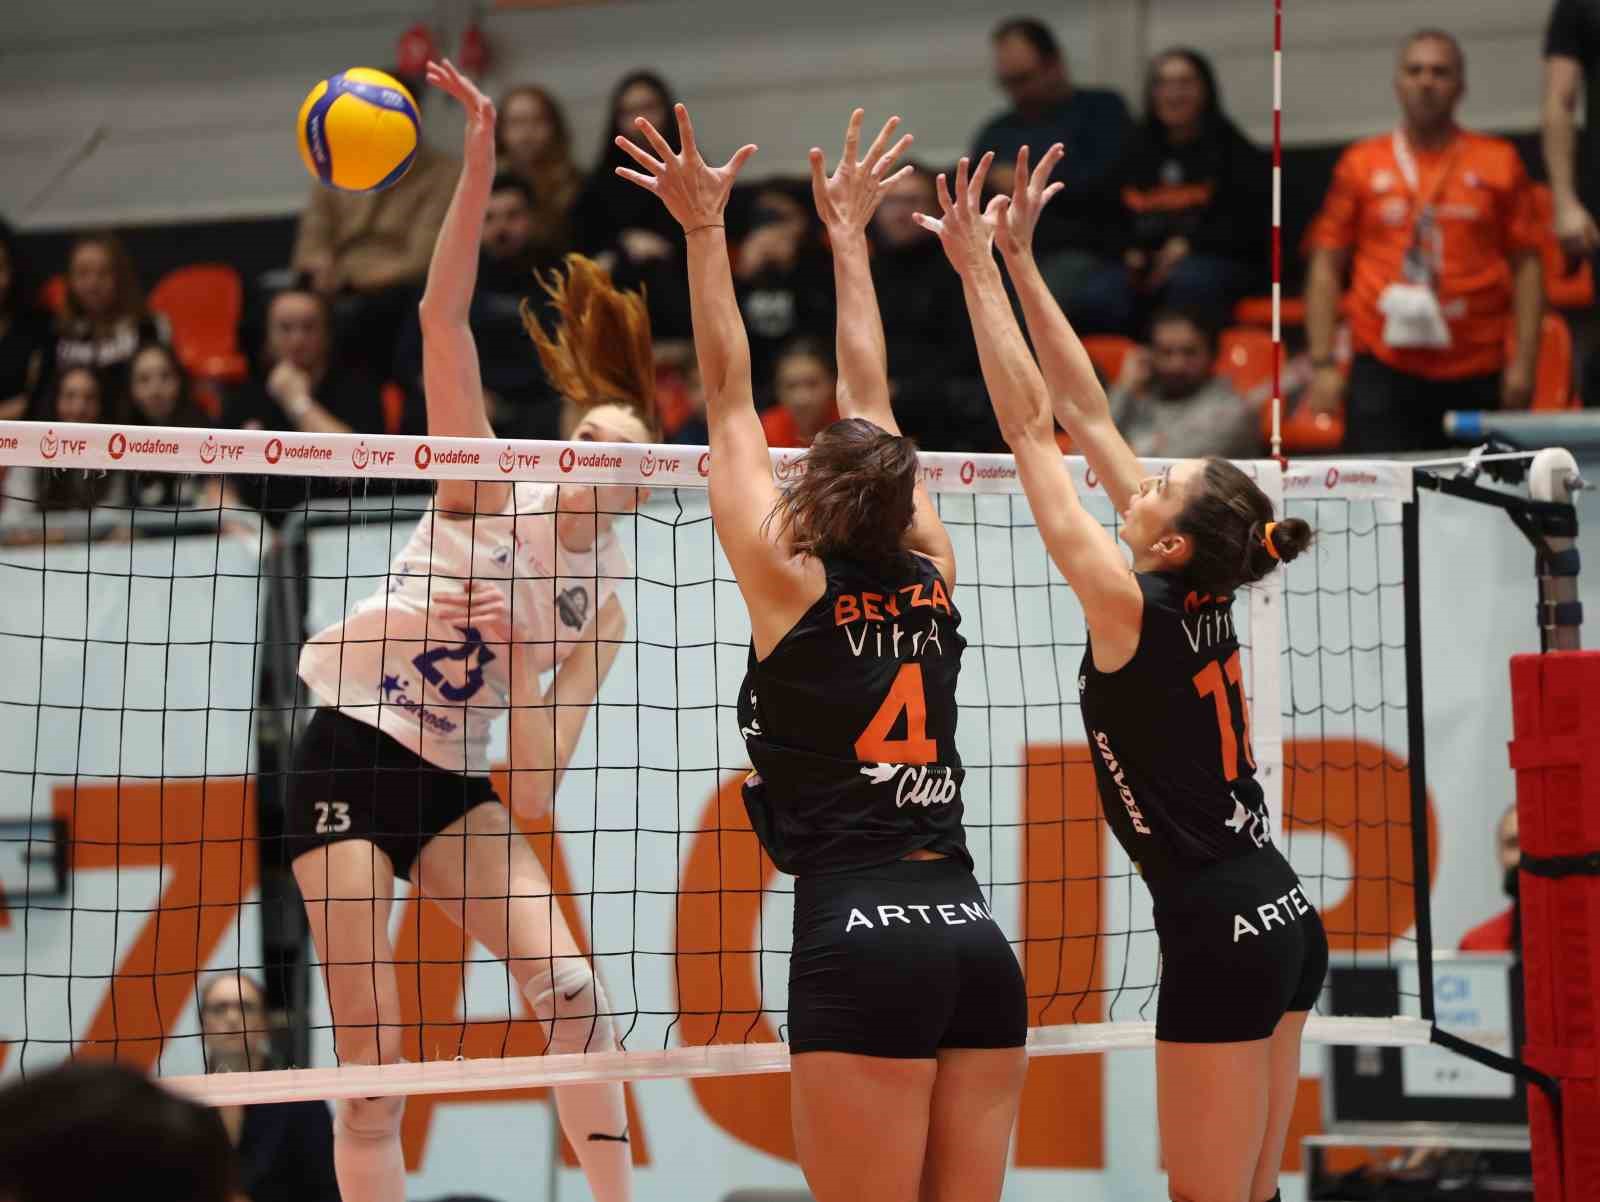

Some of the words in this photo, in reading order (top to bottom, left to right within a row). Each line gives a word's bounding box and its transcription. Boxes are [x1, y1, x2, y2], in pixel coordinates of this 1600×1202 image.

[61, 440, 87, 455] TVF
[129, 438, 180, 454] vodafone
[219, 445, 244, 460] TVF
[284, 444, 333, 460] vodafone
[371, 450, 396, 465] TVF
[433, 449, 480, 465] vodafone
[517, 454, 541, 470] TVF
[577, 454, 622, 468] vodafone
[657, 458, 680, 473] TVF
[844, 618, 942, 658] VitrA
[1181, 609, 1234, 654] Vitr
[854, 663, 938, 765] 4
[896, 766, 957, 808] Club
[314, 801, 351, 835] 23
[1233, 883, 1312, 943] ARTE
